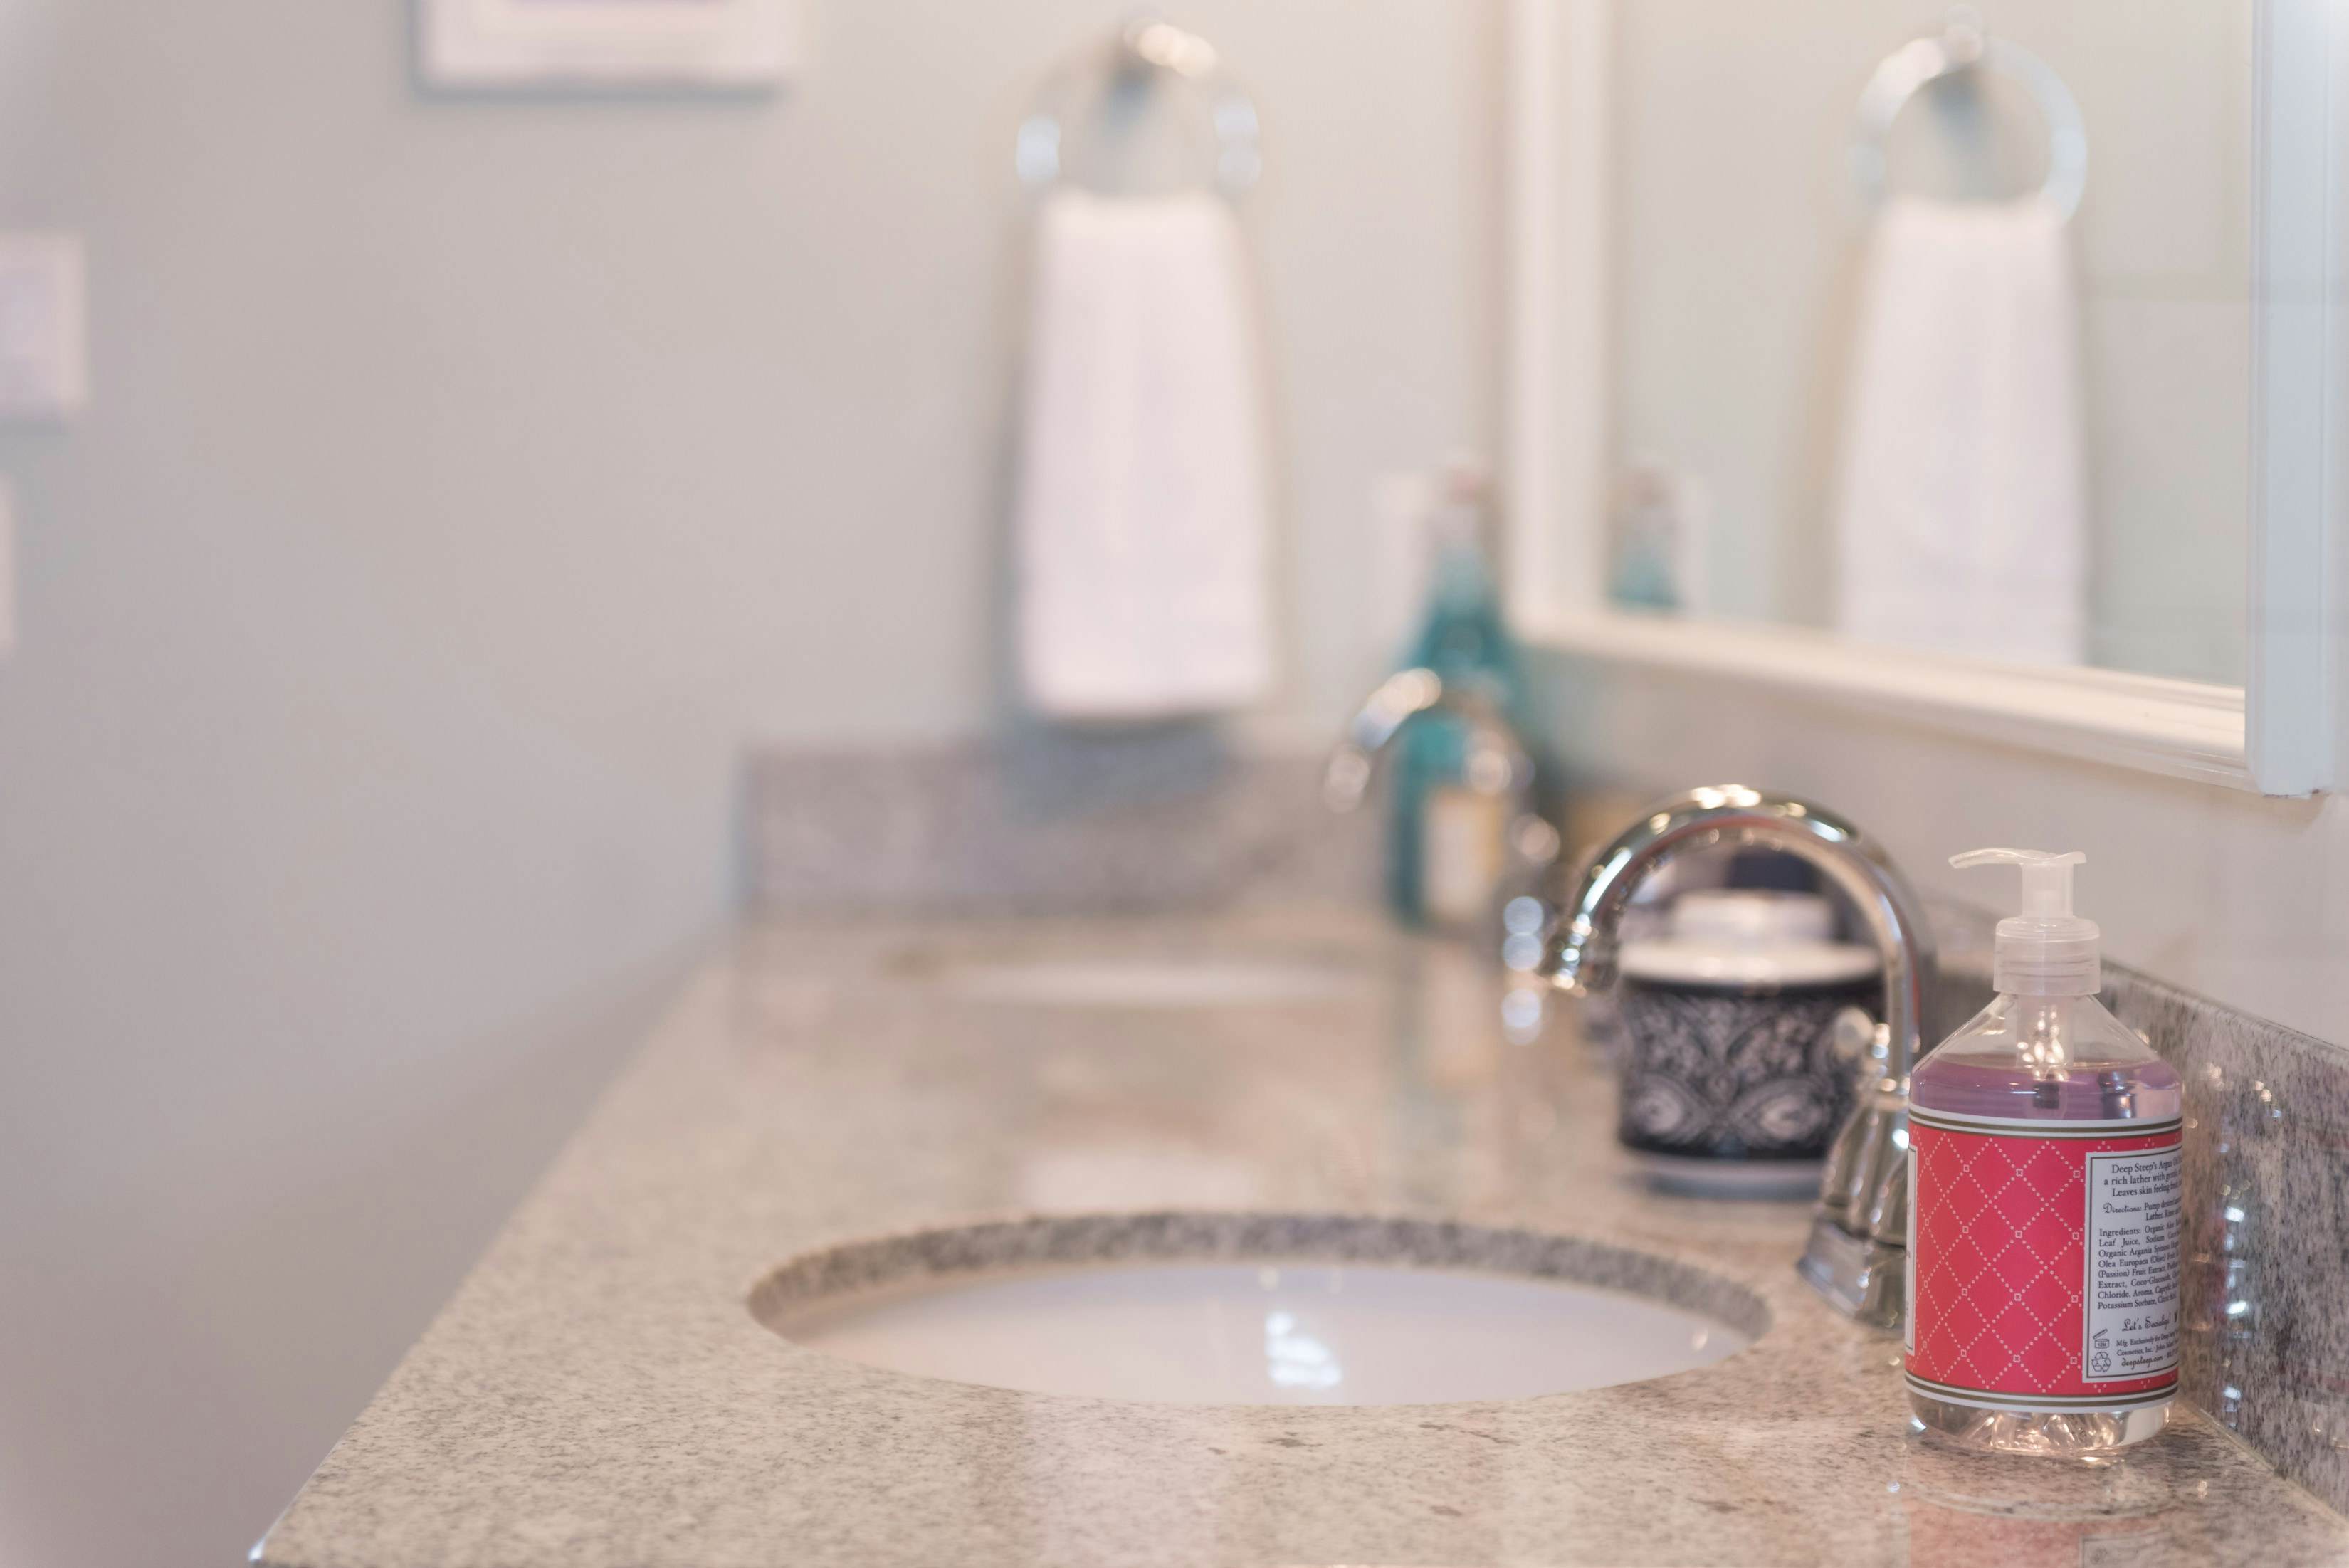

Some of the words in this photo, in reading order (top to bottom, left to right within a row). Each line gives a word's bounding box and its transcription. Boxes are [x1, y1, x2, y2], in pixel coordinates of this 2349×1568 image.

[2112, 1164, 2133, 1175] Deep
[2135, 1162, 2157, 1173] Steep's
[2111, 1176, 2128, 1185] rich
[2130, 1175, 2150, 1184] lather
[2153, 1173, 2165, 1182] with
[2113, 1188, 2137, 1196] Leaves
[2139, 1186, 2153, 1195] skin
[2154, 1184, 2170, 1194] feeling
[2103, 1202, 2142, 1213] Directions:
[2144, 1202, 2160, 1211] Pump
[2099, 1228, 2140, 1238] Ingredients:
[2145, 1224, 2165, 1234] Organic
[2099, 1238, 2116, 1247] Leaf
[2121, 1238, 2140, 1248] Juice,
[2098, 1249, 2127, 1259] Organic
[2130, 1248, 2152, 1257] Argania
[2119, 1258, 2148, 1268] Europaea
[2098, 1269, 2130, 1278] (Passion)
[2132, 1268, 2146, 1276] Fruit
[2098, 1290, 2131, 1299] Chloride,
[2098, 1301, 2133, 1310] Potassium
[2135, 1298, 2157, 1307] Sorbate,
[2122, 1317, 2142, 1331] Let's
[2121, 1356, 2163, 1370] deepsteep.com
